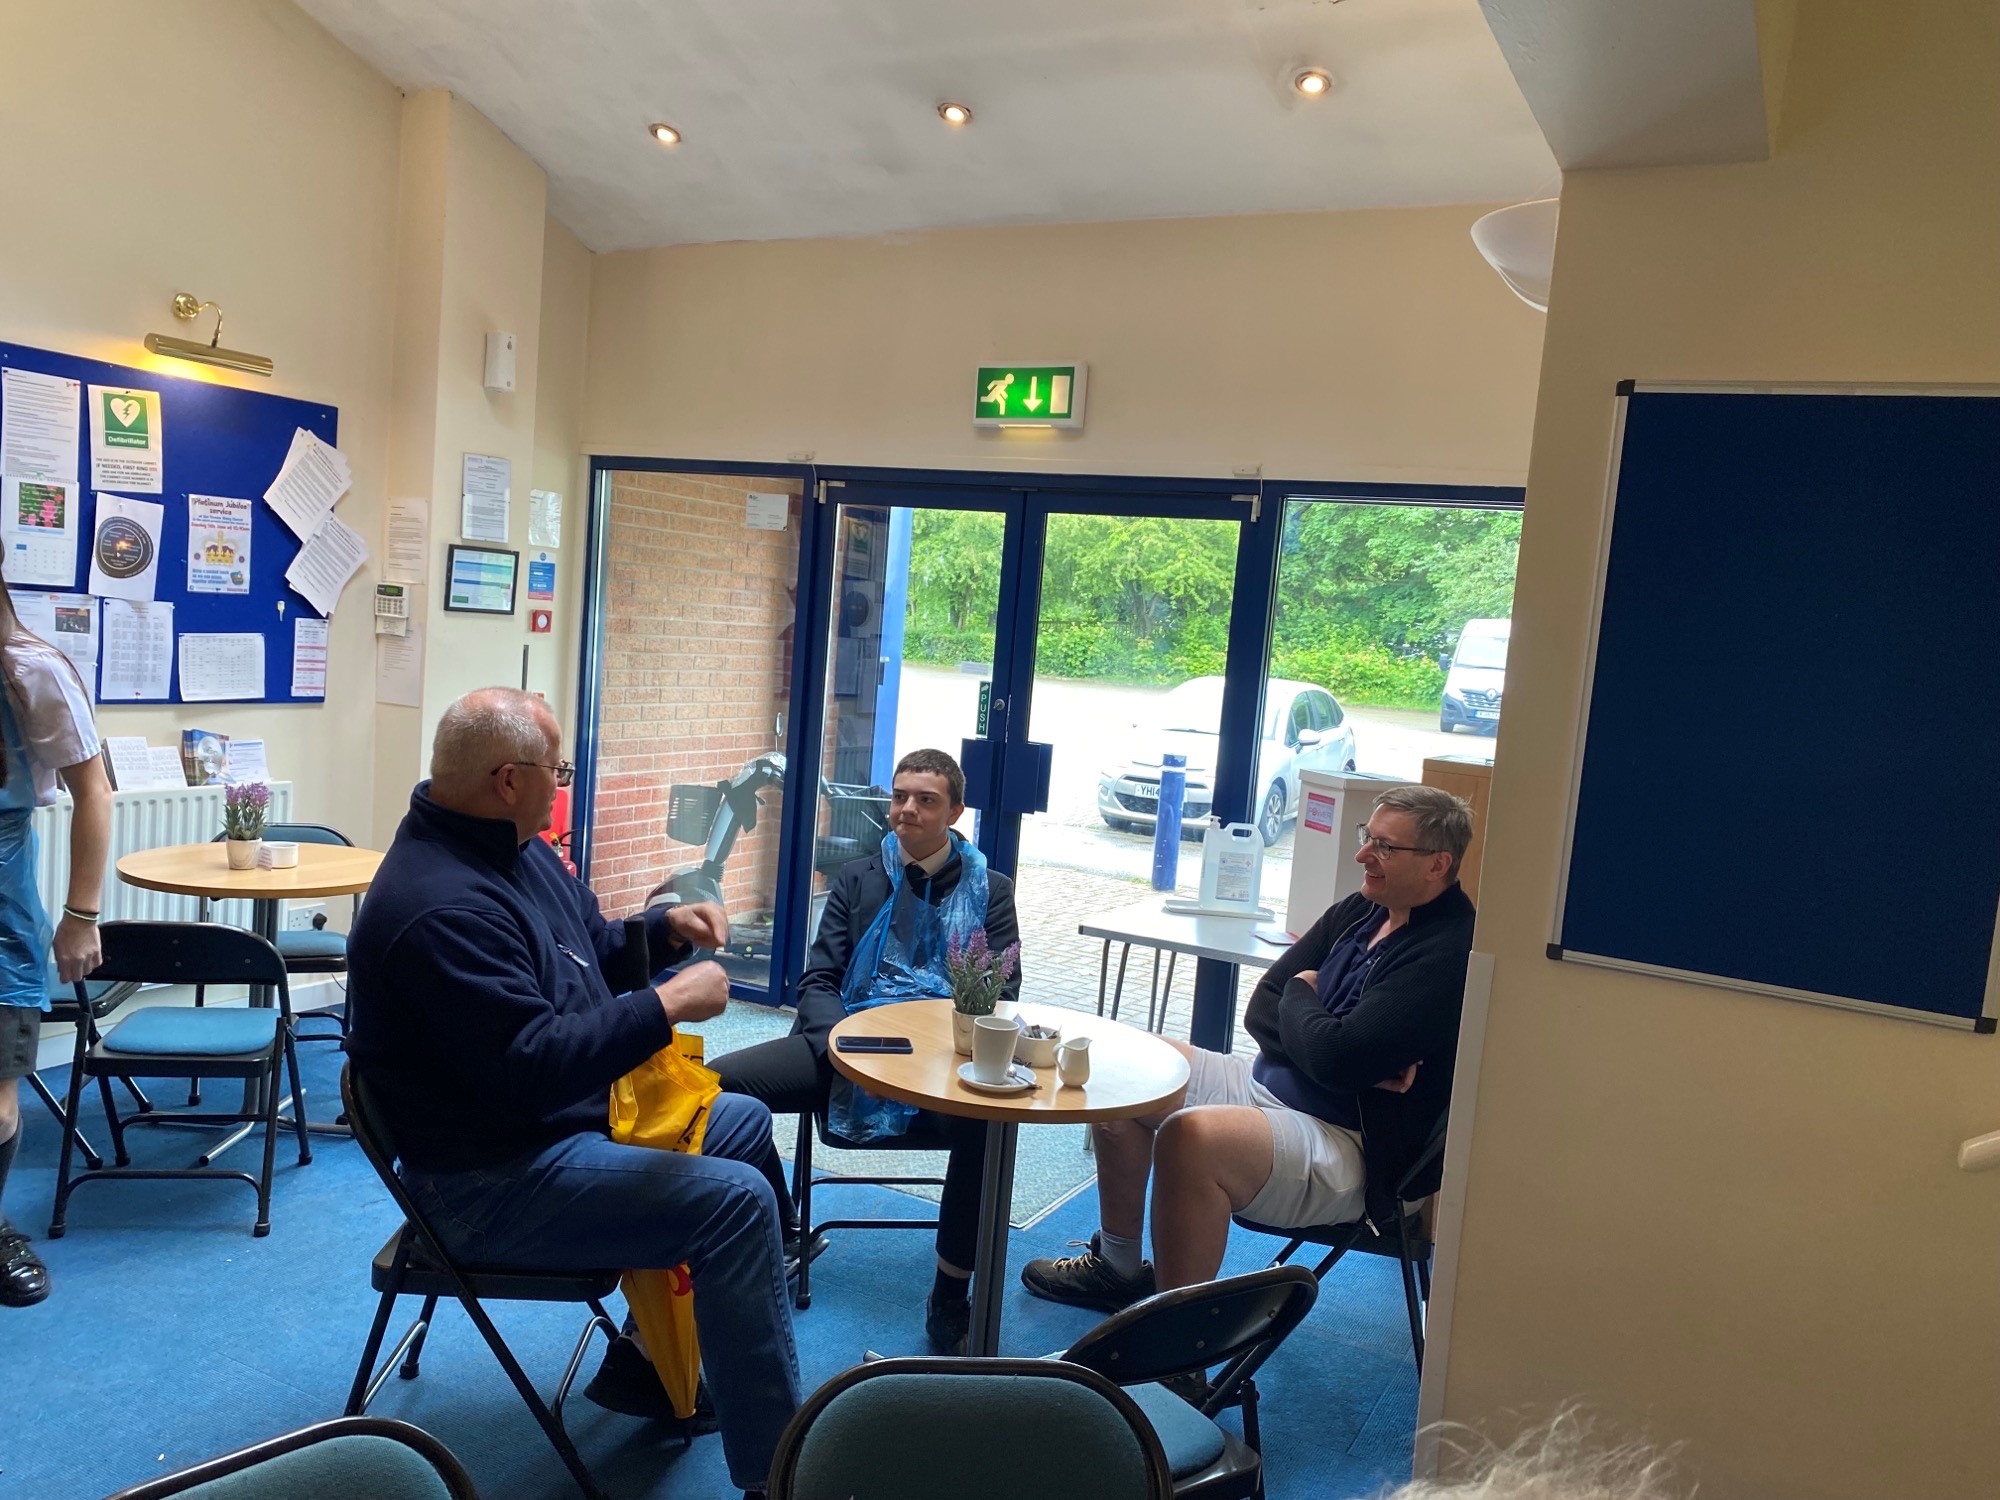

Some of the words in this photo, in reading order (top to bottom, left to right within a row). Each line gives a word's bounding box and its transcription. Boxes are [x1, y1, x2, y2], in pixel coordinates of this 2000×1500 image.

[108, 436, 146, 446] Defibrillator
[210, 507, 232, 516] service
[979, 693, 987, 732] PUSH
